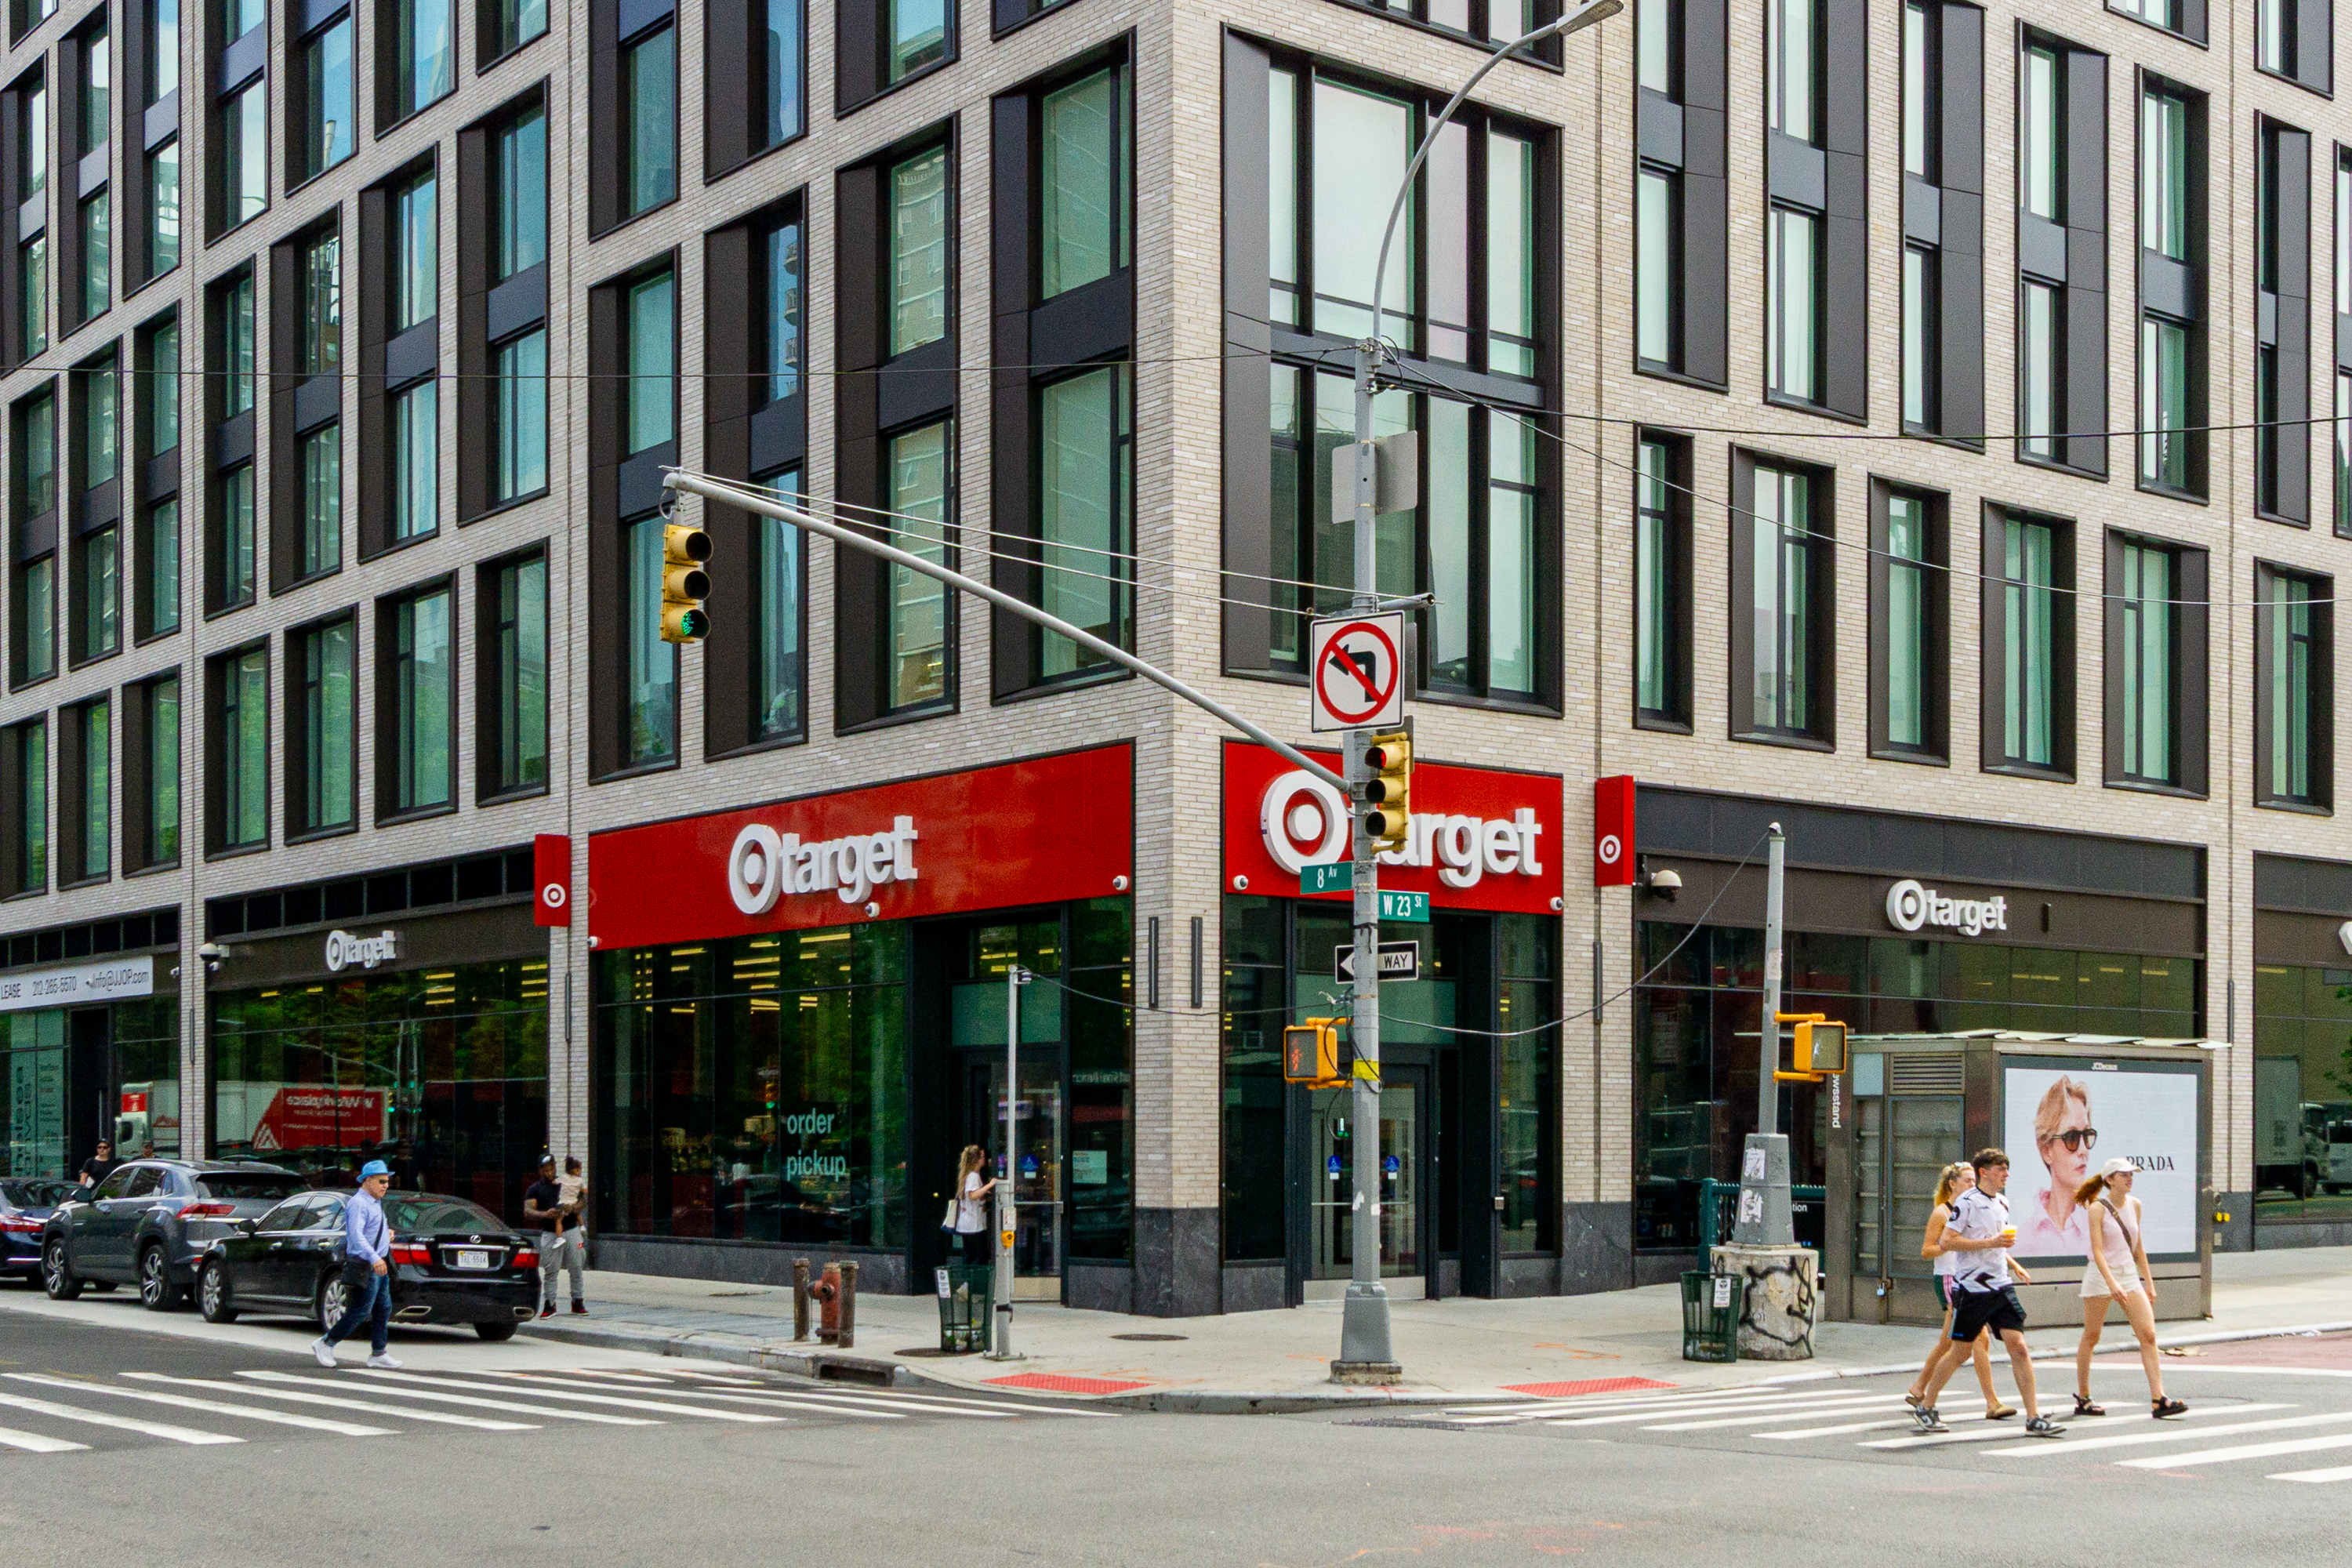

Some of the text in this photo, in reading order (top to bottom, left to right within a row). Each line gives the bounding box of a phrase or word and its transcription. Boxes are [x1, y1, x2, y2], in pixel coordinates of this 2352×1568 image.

[779, 815, 919, 904] target
[1348, 808, 1542, 887] arget
[1317, 866, 1338, 889] 8 Av
[1384, 895, 1422, 916] W 23 St
[1924, 889, 2007, 936] target
[345, 930, 396, 968] target
[1384, 954, 1408, 969] WAY
[1, 983, 21, 1000] LEASE
[1832, 1073, 1842, 1129] ewsstand
[787, 1107, 835, 1134] order
[786, 1149, 846, 1181] pickup
[2126, 1156, 2175, 1171] PRADA
[1792, 1203, 1808, 1212] tion
